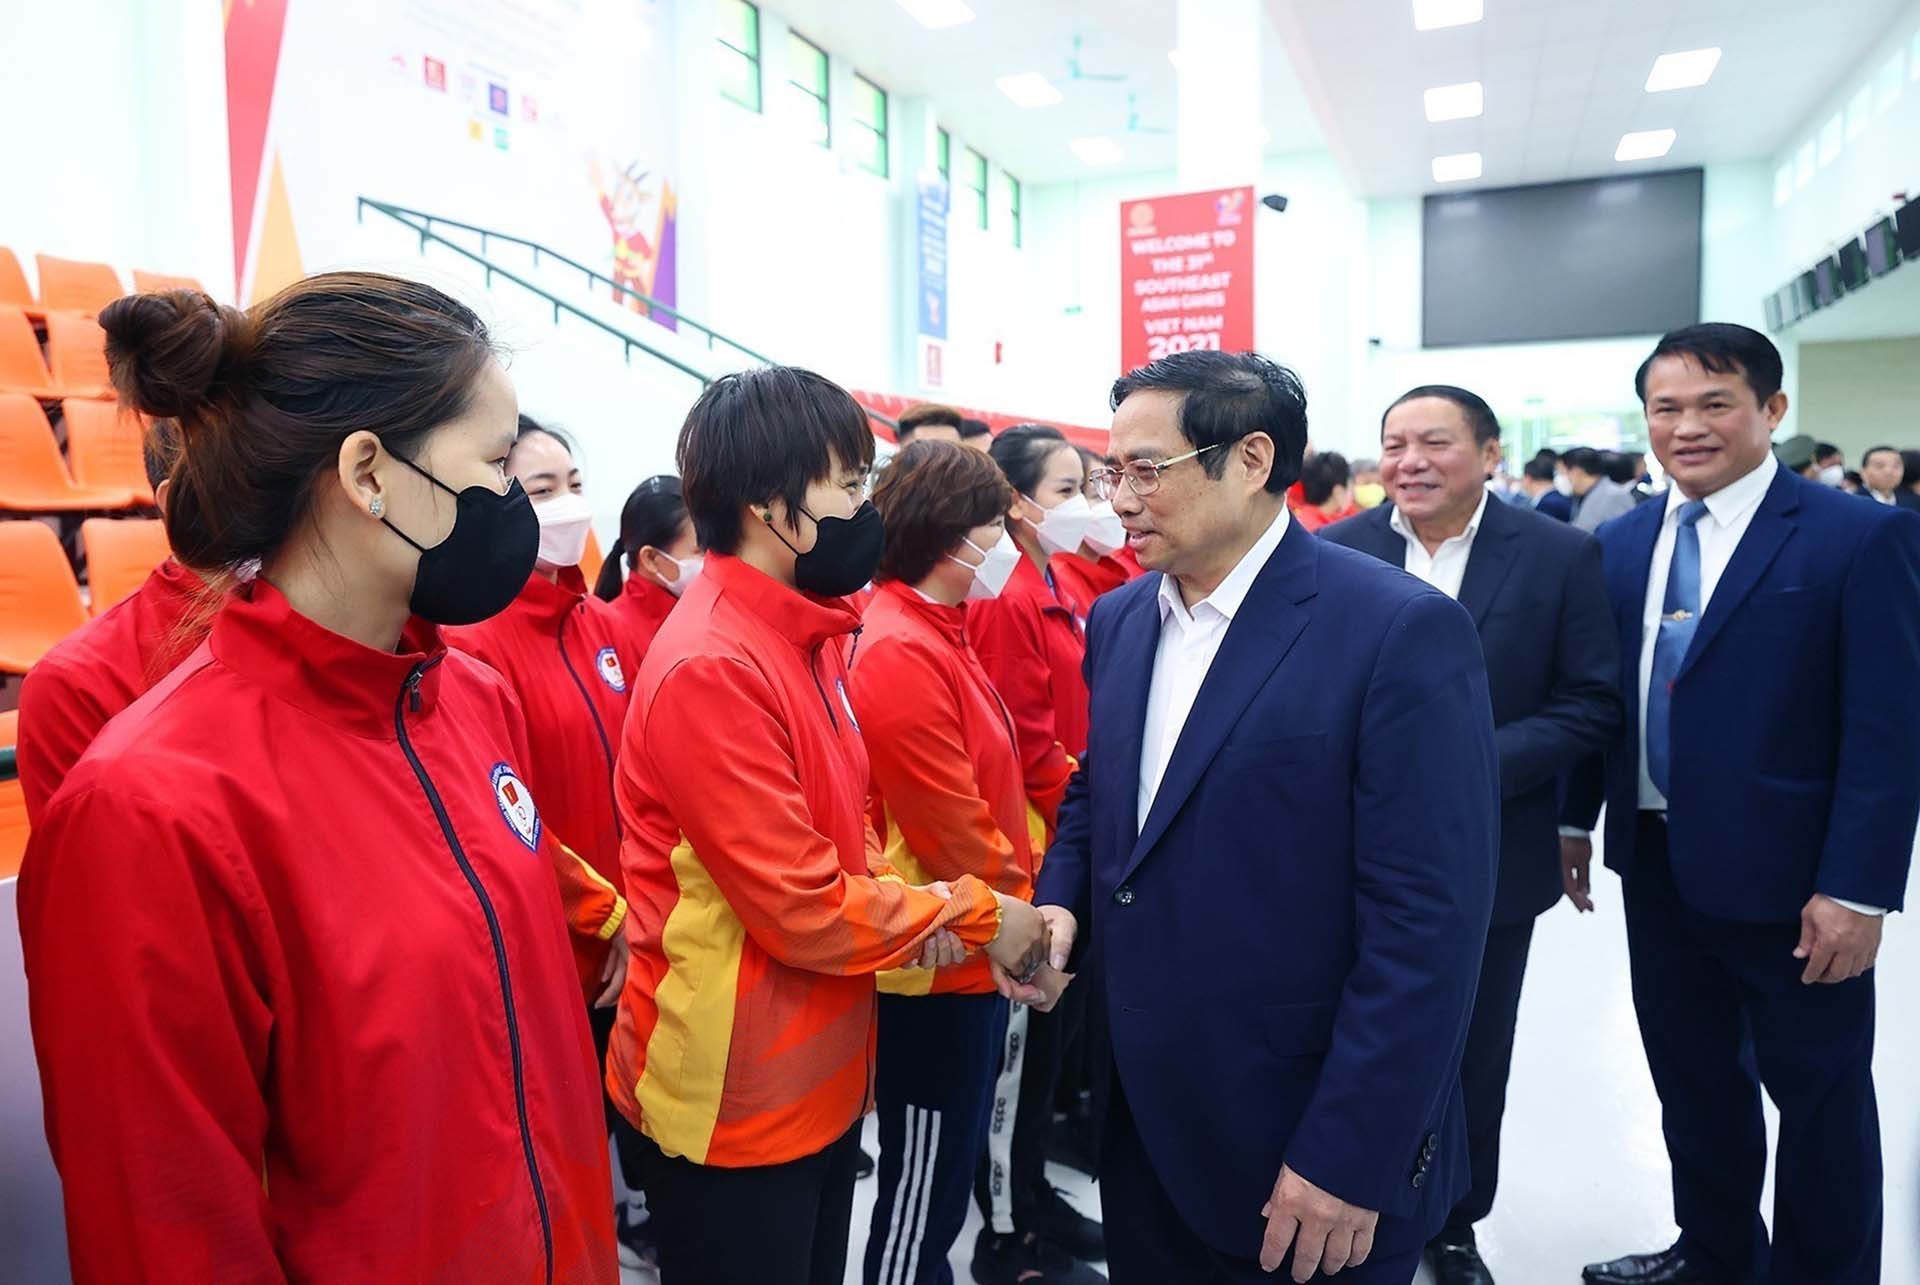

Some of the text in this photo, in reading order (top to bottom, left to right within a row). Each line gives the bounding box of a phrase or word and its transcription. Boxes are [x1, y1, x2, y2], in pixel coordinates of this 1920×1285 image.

[1131, 230, 1236, 254] WELCOME TO
[1152, 256, 1183, 273] THE
[1134, 273, 1231, 295] SOUTHEAST
[1144, 315, 1224, 334] VIET NAM
[1147, 332, 1221, 360] 2021
